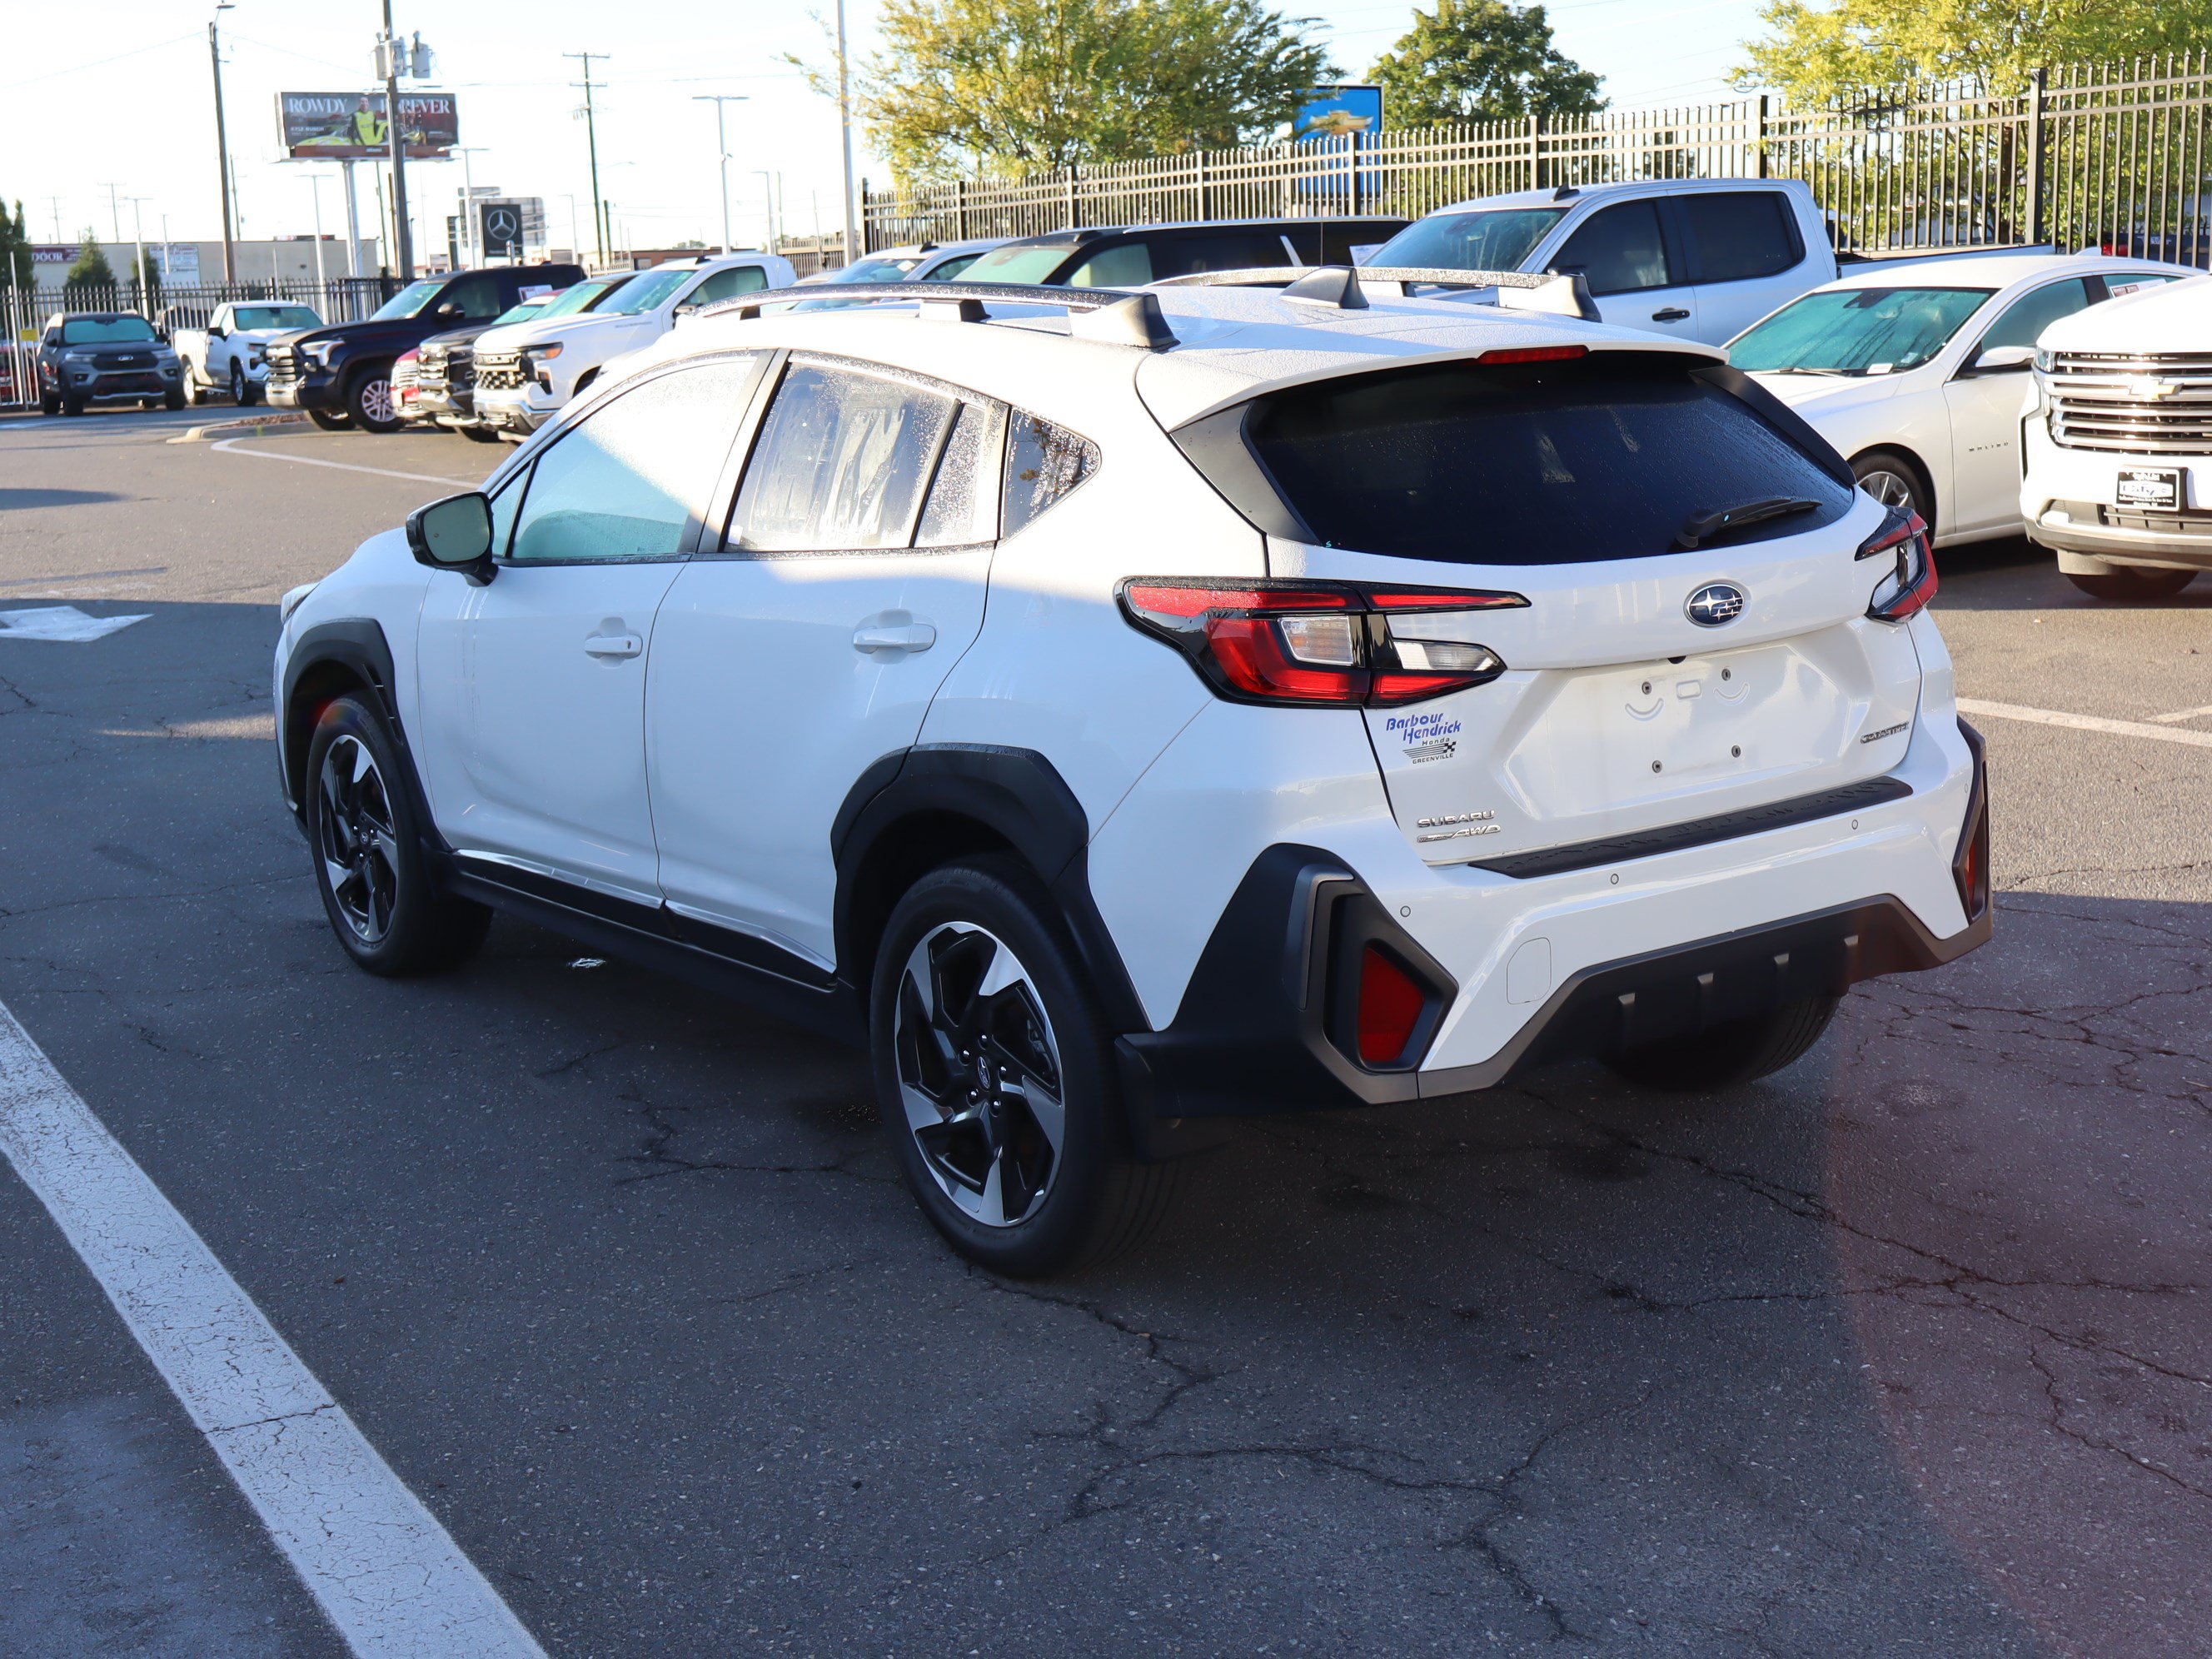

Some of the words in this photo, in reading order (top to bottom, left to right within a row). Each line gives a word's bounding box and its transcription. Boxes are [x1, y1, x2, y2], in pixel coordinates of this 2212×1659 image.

[288, 97, 347, 114] ROWDY
[380, 98, 451, 114] FREVER
[1386, 713, 1444, 731] Barbour
[1402, 720, 1462, 745] Hendrick
[1422, 737, 1450, 746] Honda
[1412, 753, 1454, 765] GREENVILLE
[1417, 810, 1495, 828] SUBARU
[1451, 825, 1502, 839] AWD
